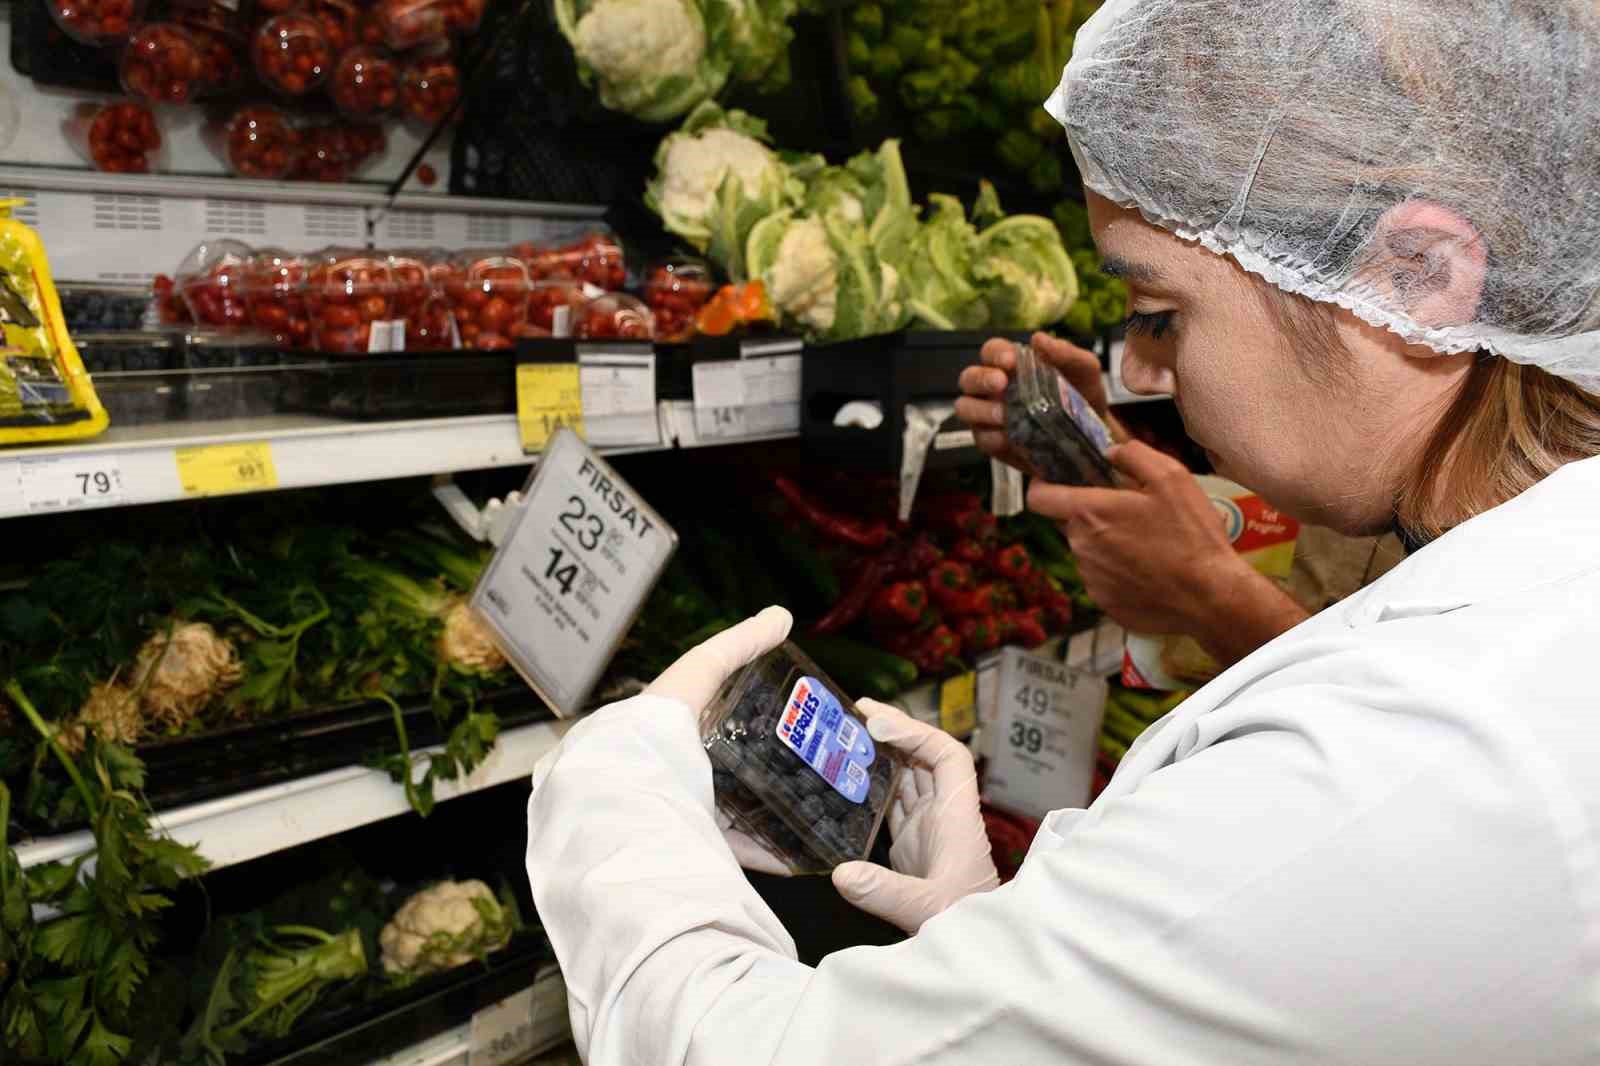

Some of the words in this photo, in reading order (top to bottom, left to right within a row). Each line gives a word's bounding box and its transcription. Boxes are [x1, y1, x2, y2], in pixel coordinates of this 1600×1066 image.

[75, 471, 111, 495] 79
[577, 457, 655, 539] FIRSAT
[559, 495, 605, 551] 23
[545, 546, 579, 596] 14
[789, 692, 820, 749] BERRIES
[1015, 684, 1049, 715] 49
[1009, 721, 1043, 754] 39
